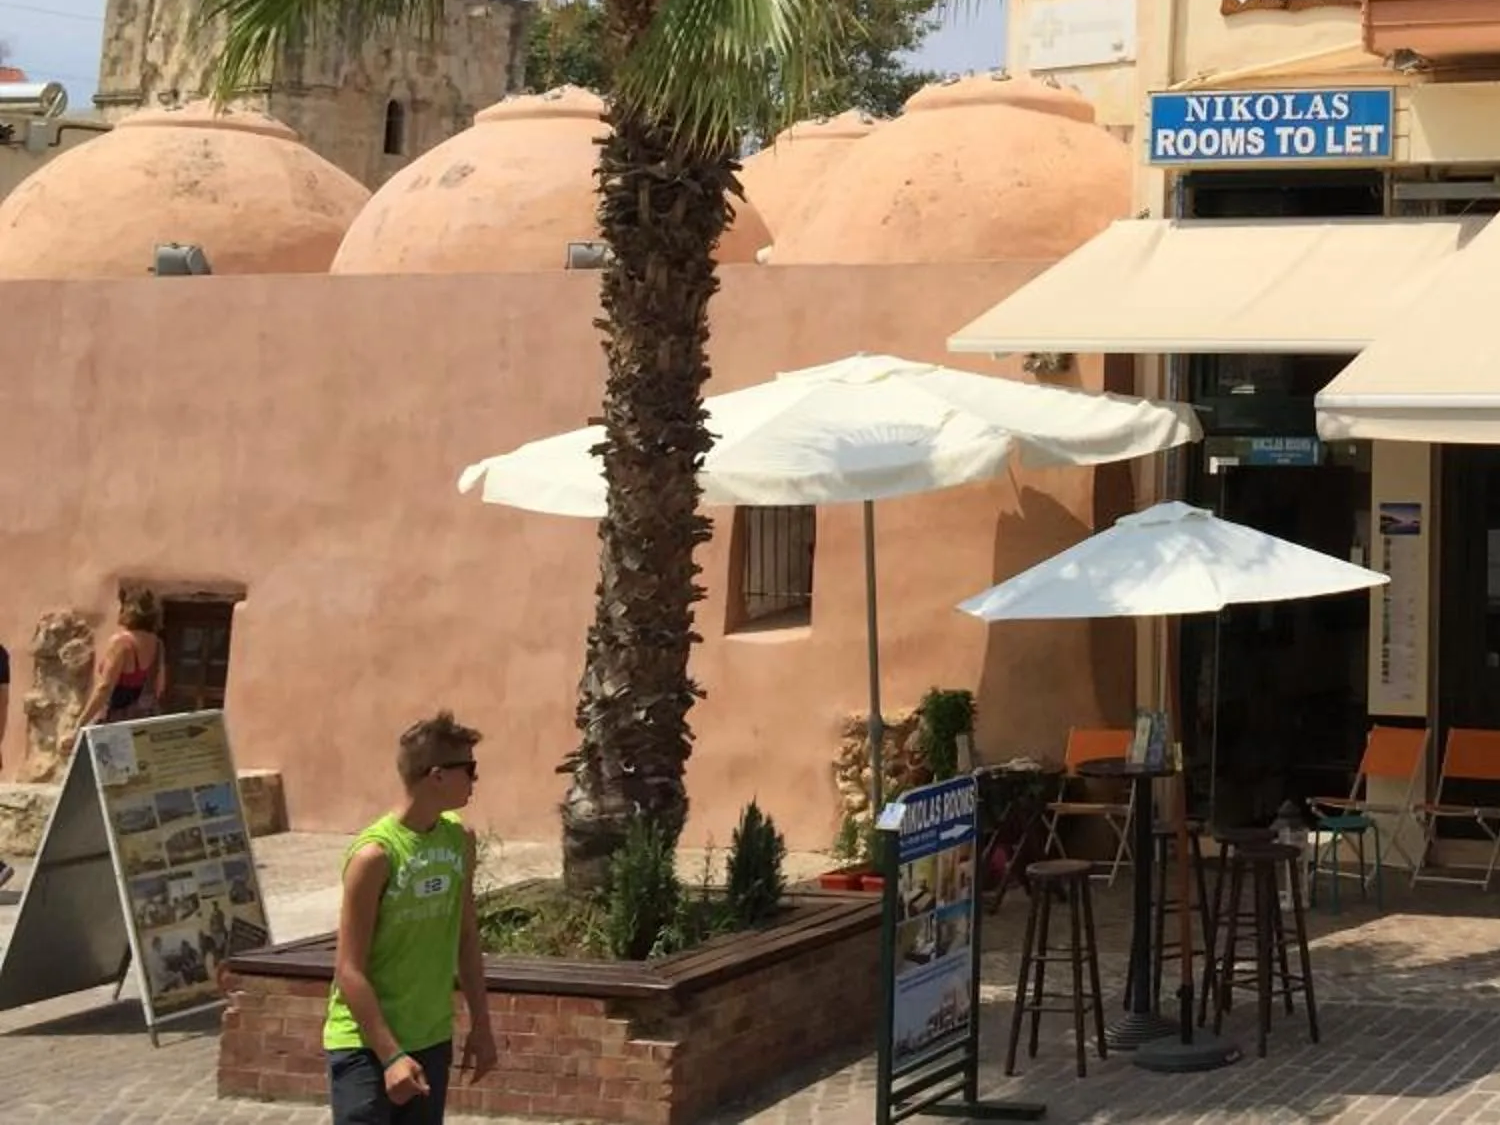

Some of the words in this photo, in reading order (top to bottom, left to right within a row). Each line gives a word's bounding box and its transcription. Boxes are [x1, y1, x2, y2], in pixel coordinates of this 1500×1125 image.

[1185, 94, 1350, 122] NIKOLAS
[1155, 127, 1266, 156] ROOMS
[1275, 126, 1317, 155] TO
[1326, 125, 1384, 154] LET
